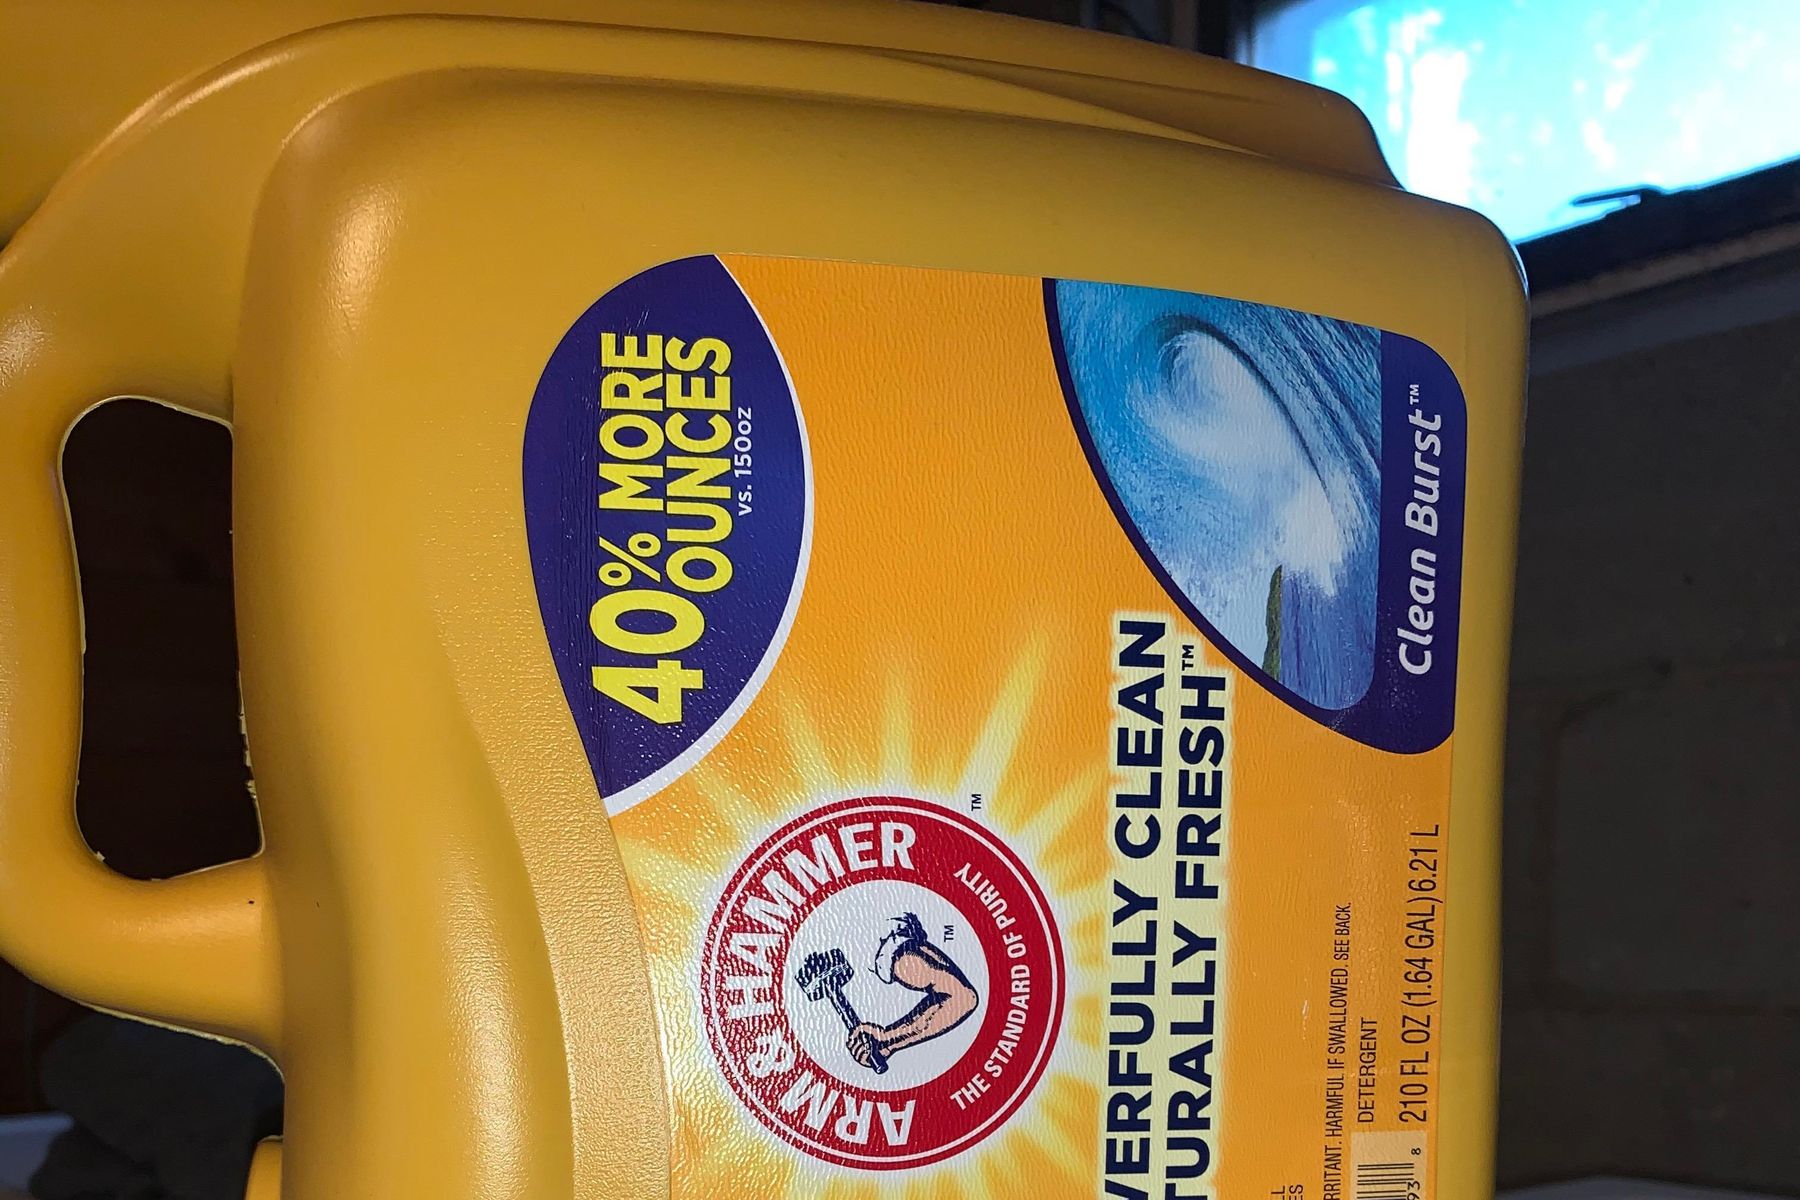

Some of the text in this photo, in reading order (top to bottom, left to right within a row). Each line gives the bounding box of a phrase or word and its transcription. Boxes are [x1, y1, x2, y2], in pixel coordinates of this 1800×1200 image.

[666, 337, 732, 592] OUNCES
[734, 407, 752, 516] vs. 150oz
[590, 333, 705, 724] 40% MORE
[1397, 549, 1437, 675] Clean
[1115, 620, 1166, 859] CLEAN
[1334, 939, 1349, 960] SEE
[1336, 902, 1351, 936] BACK.
[1399, 824, 1443, 1122] 210 FL OZ (1.64 GAL) 6.21 L
[727, 821, 916, 1146] ARM & HAMMER
[950, 862, 1030, 1110] THE STANDARD OF PURITY
[1328, 963, 1348, 1054] SWALLOWED.
[1326, 1074, 1344, 1137] HARMFUL
[1329, 1054, 1345, 1069] IF
[1358, 1017, 1377, 1122] DETERGENT
